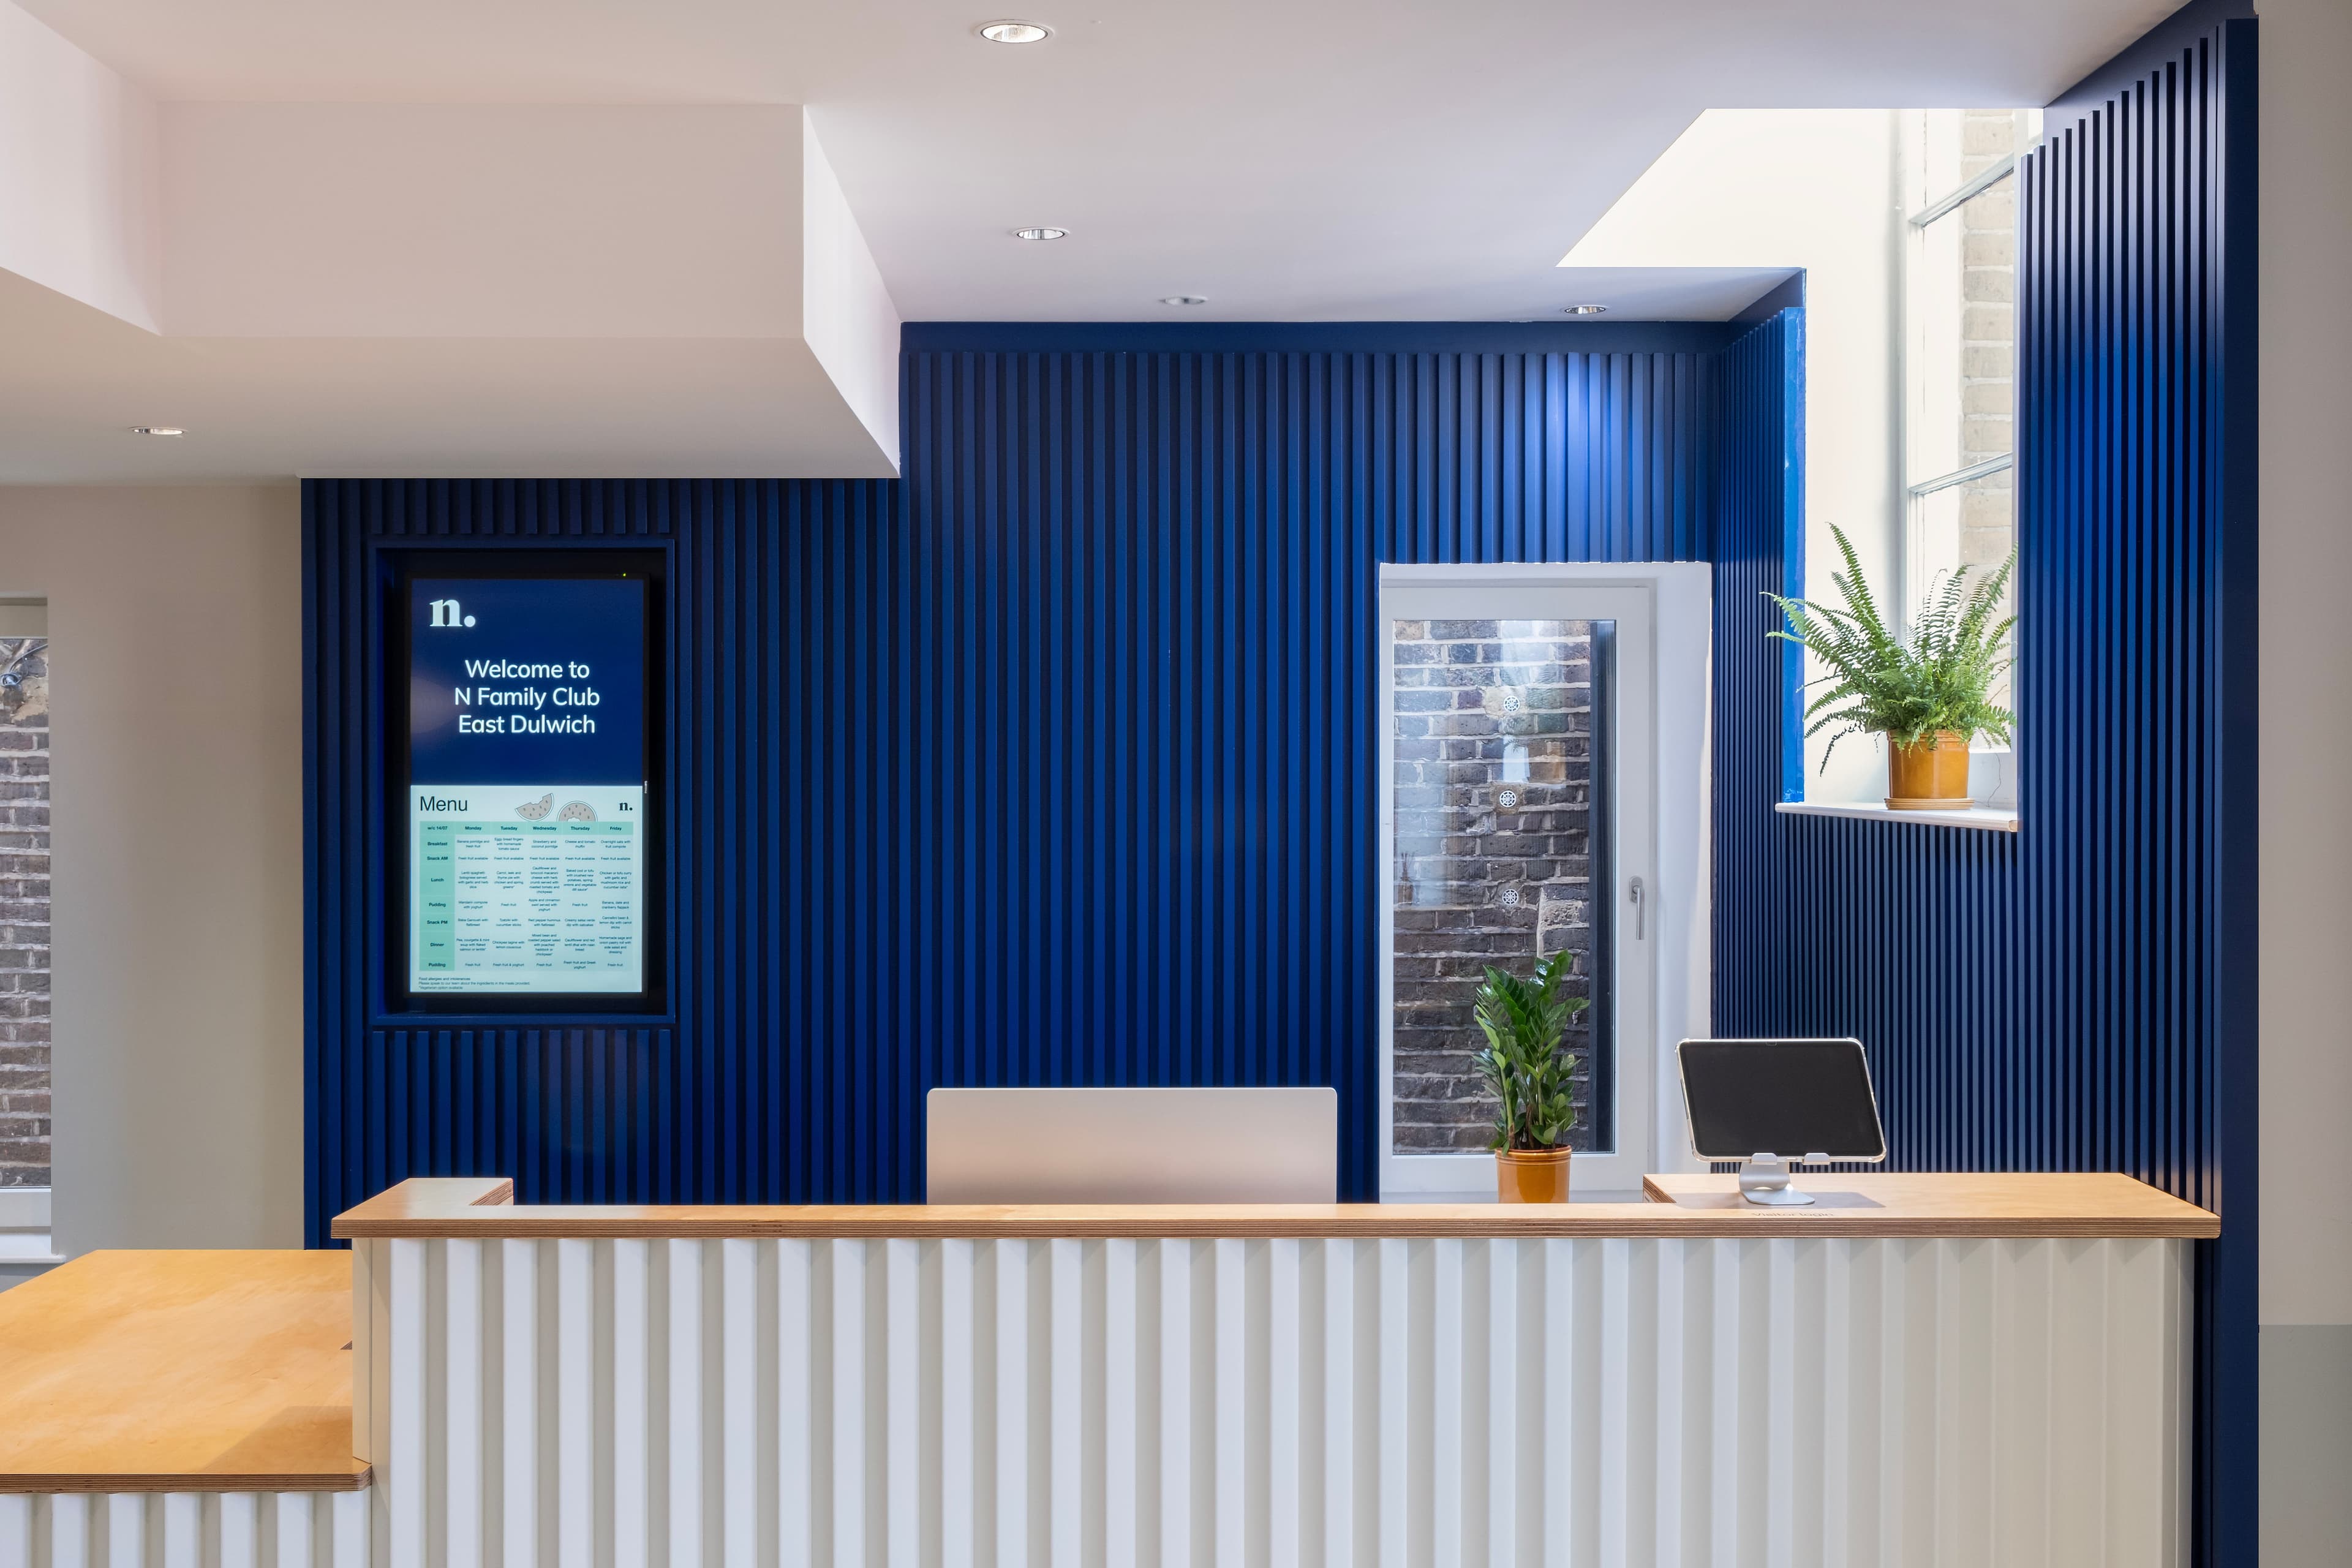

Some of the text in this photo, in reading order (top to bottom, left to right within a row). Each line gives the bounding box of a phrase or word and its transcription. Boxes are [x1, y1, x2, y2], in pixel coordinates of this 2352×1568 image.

[429, 598, 476, 627] n.
[464, 659, 590, 678] Welcome to
[454, 687, 600, 710] N Family Club
[459, 714, 595, 733] East Dulwich
[420, 796, 468, 812] Menu
[619, 801, 633, 811] n.
